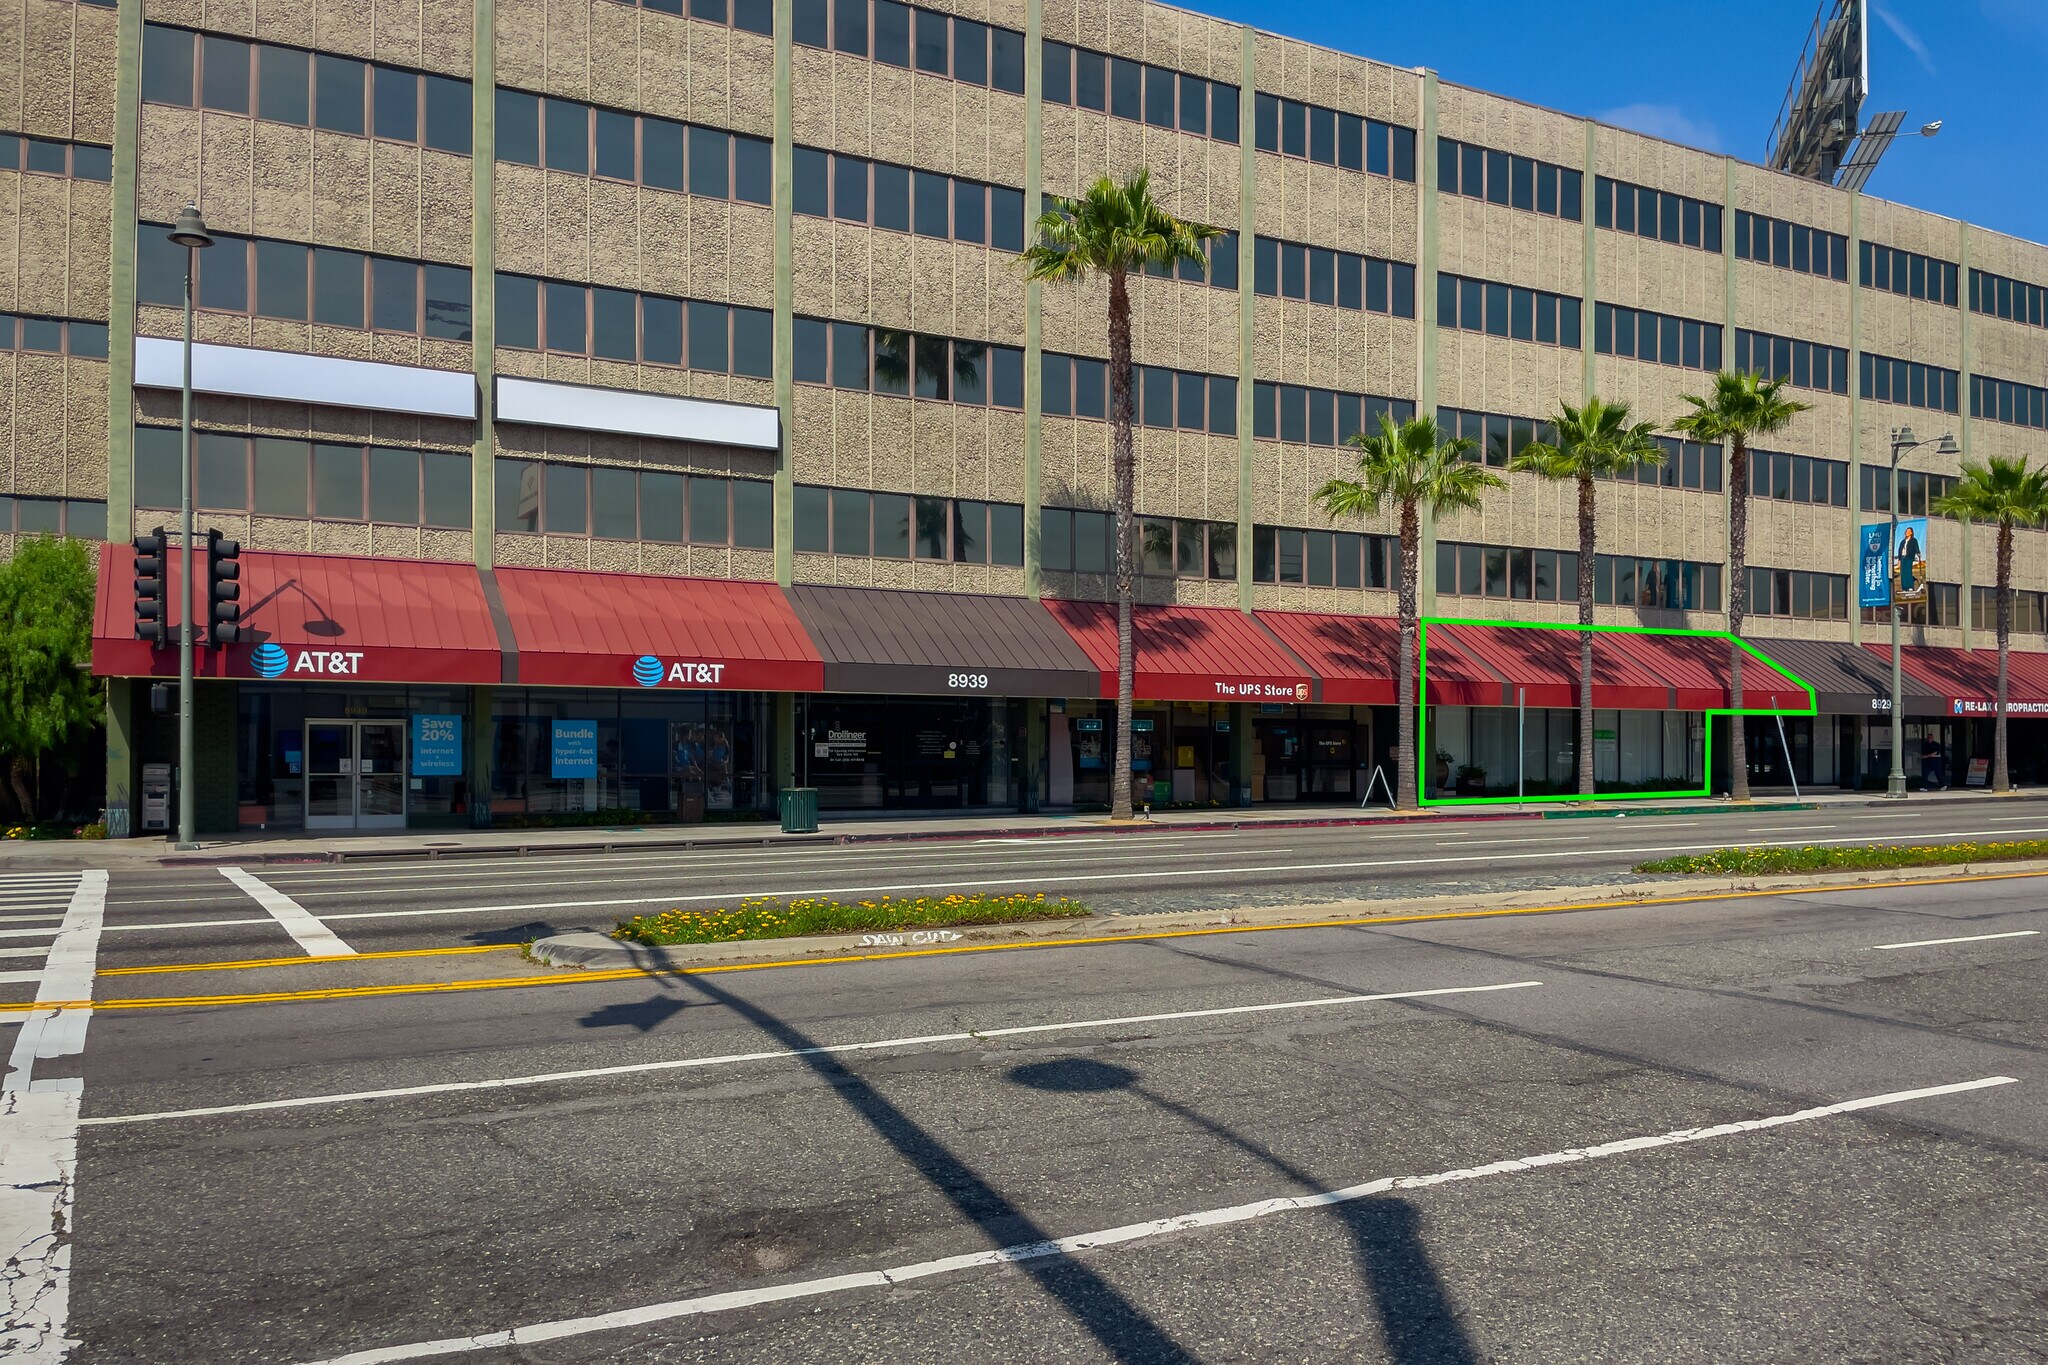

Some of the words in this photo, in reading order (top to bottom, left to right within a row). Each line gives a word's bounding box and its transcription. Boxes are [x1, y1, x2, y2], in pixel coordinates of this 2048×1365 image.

[1869, 557, 1877, 591] something
[294, 651, 364, 673] AT&T
[668, 663, 725, 683] AT&T
[948, 673, 988, 688] 8939
[1215, 682, 1235, 694] The
[1239, 684, 1261, 695] UPS
[1264, 685, 1293, 696] Store
[1872, 699, 1892, 709] 8929
[1994, 702, 2048, 712] IROPRACTIC
[421, 718, 454, 729] Save
[421, 729, 455, 741] 20%
[555, 729, 594, 739] Bundle
[828, 730, 866, 740] Drollinger
[859, 934, 904, 946] SAW
[912, 931, 951, 944] CUT
